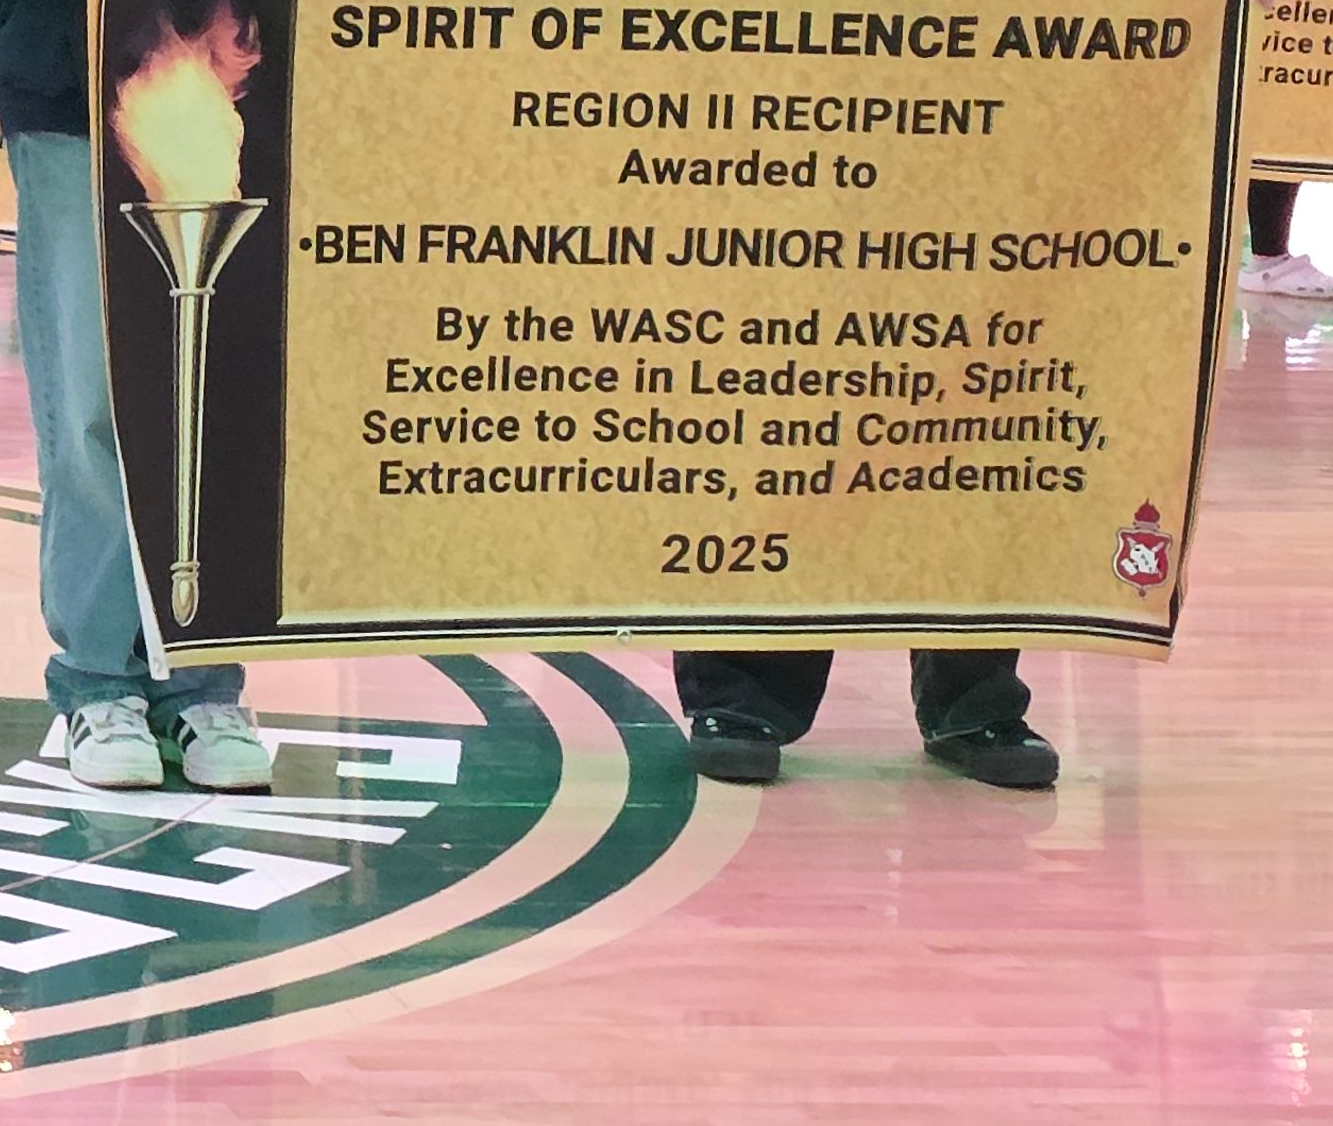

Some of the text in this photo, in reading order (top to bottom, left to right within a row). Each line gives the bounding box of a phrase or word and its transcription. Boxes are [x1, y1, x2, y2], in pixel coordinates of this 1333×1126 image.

[330, 5, 1192, 60] SPIRIT OF EXCELLENCE AWARD
[513, 90, 1005, 135] REGION II RECIPIENT
[618, 148, 878, 189] Awarded to
[417, 223, 654, 266] FRANKLIN
[666, 226, 845, 270] JUNIOR
[857, 230, 979, 271] HIGH
[435, 306, 1045, 351] By the WASC and AWSA for
[385, 355, 1088, 406] Excellence in Leadership, Spirit,
[361, 406, 1109, 452] Service to School and Community,
[378, 455, 1088, 502] Extracurriculars, and Academics
[661, 533, 790, 574] 2025
